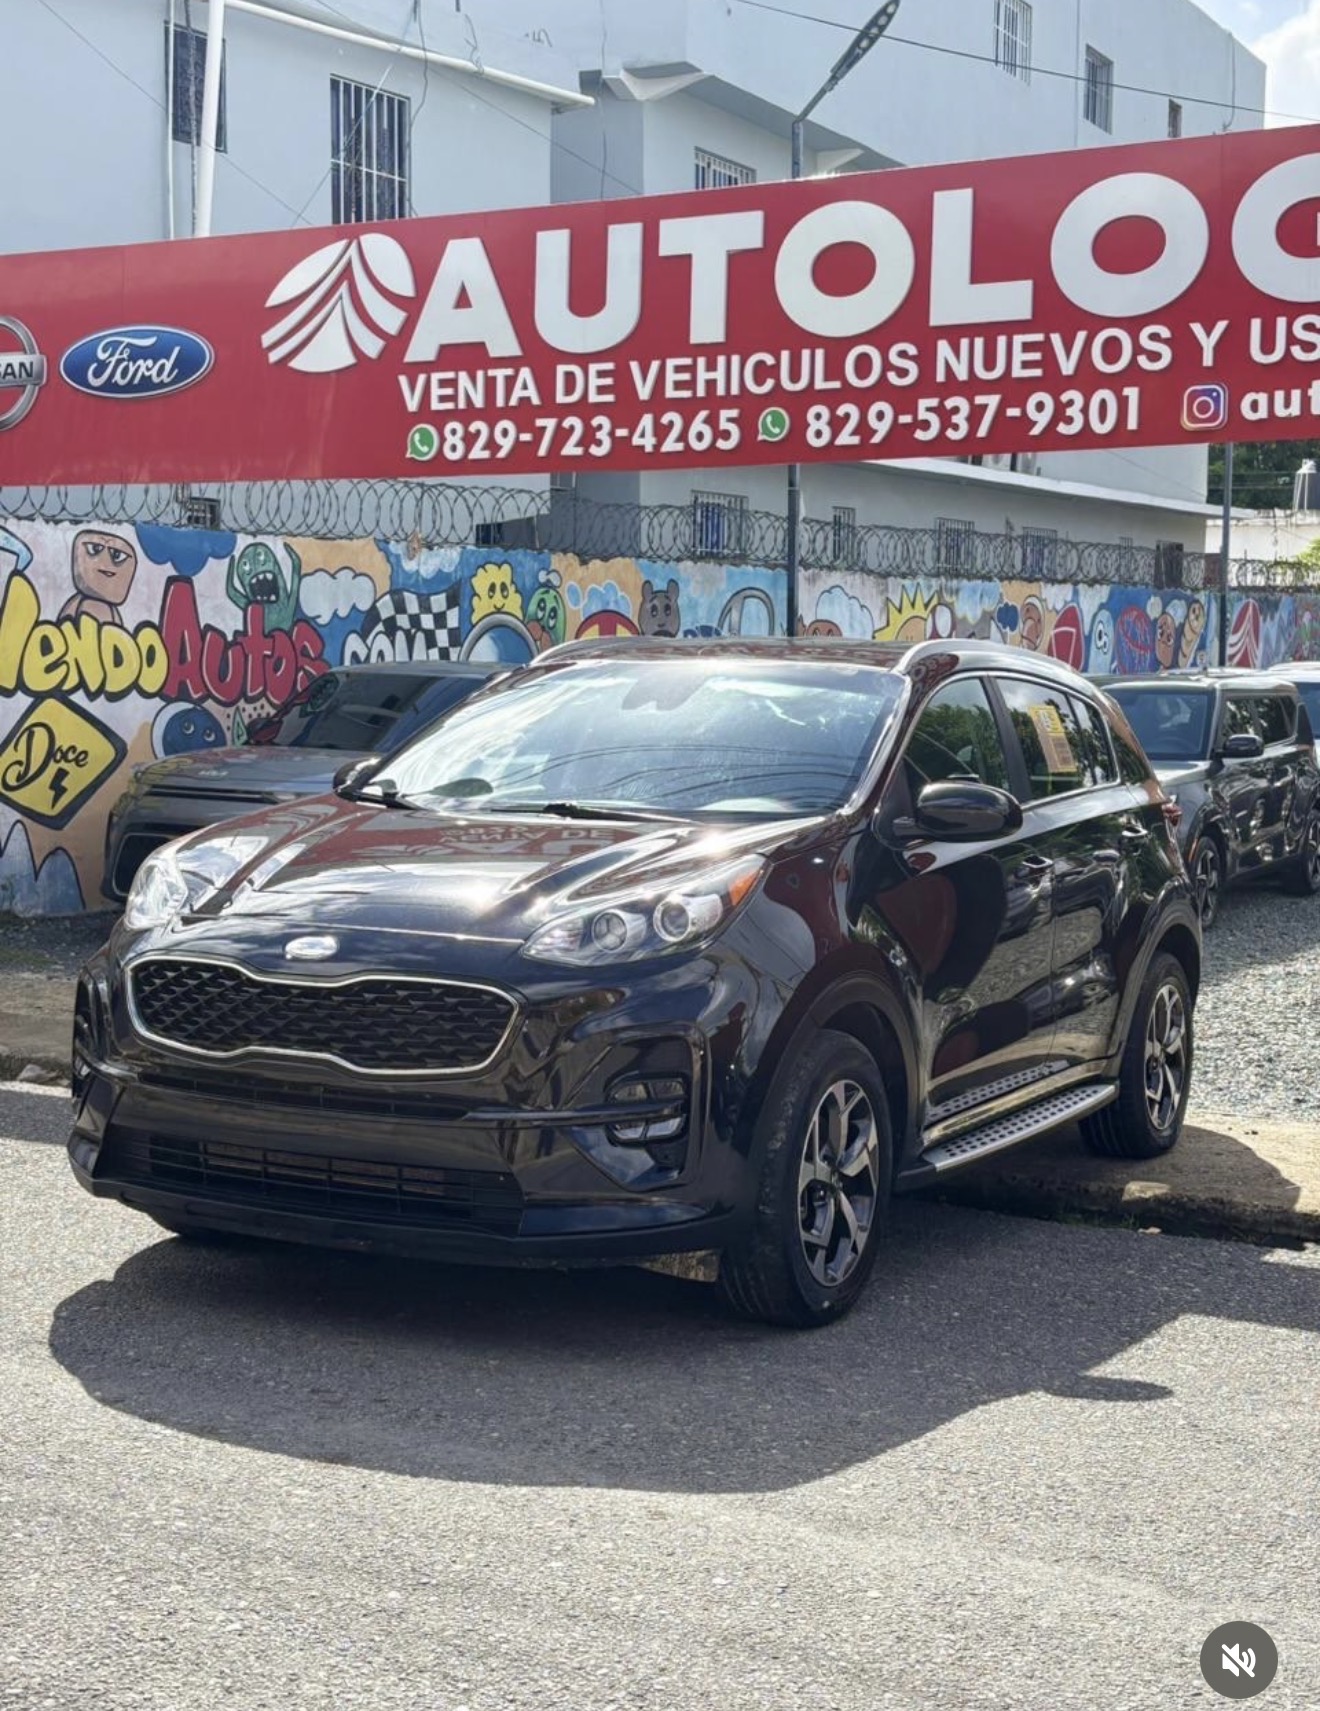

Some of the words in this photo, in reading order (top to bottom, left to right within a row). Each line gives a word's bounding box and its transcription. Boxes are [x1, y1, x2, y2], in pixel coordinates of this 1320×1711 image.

[88, 336, 180, 387] Ford
[398, 366, 541, 413] VENTA
[555, 361, 616, 405] DE
[630, 342, 919, 402] VEHICULOS
[935, 325, 1171, 383] NUEVOS
[1189, 319, 1230, 367] Y
[441, 407, 741, 461] 829-723-4265
[806, 387, 1142, 448] 829-537-9301
